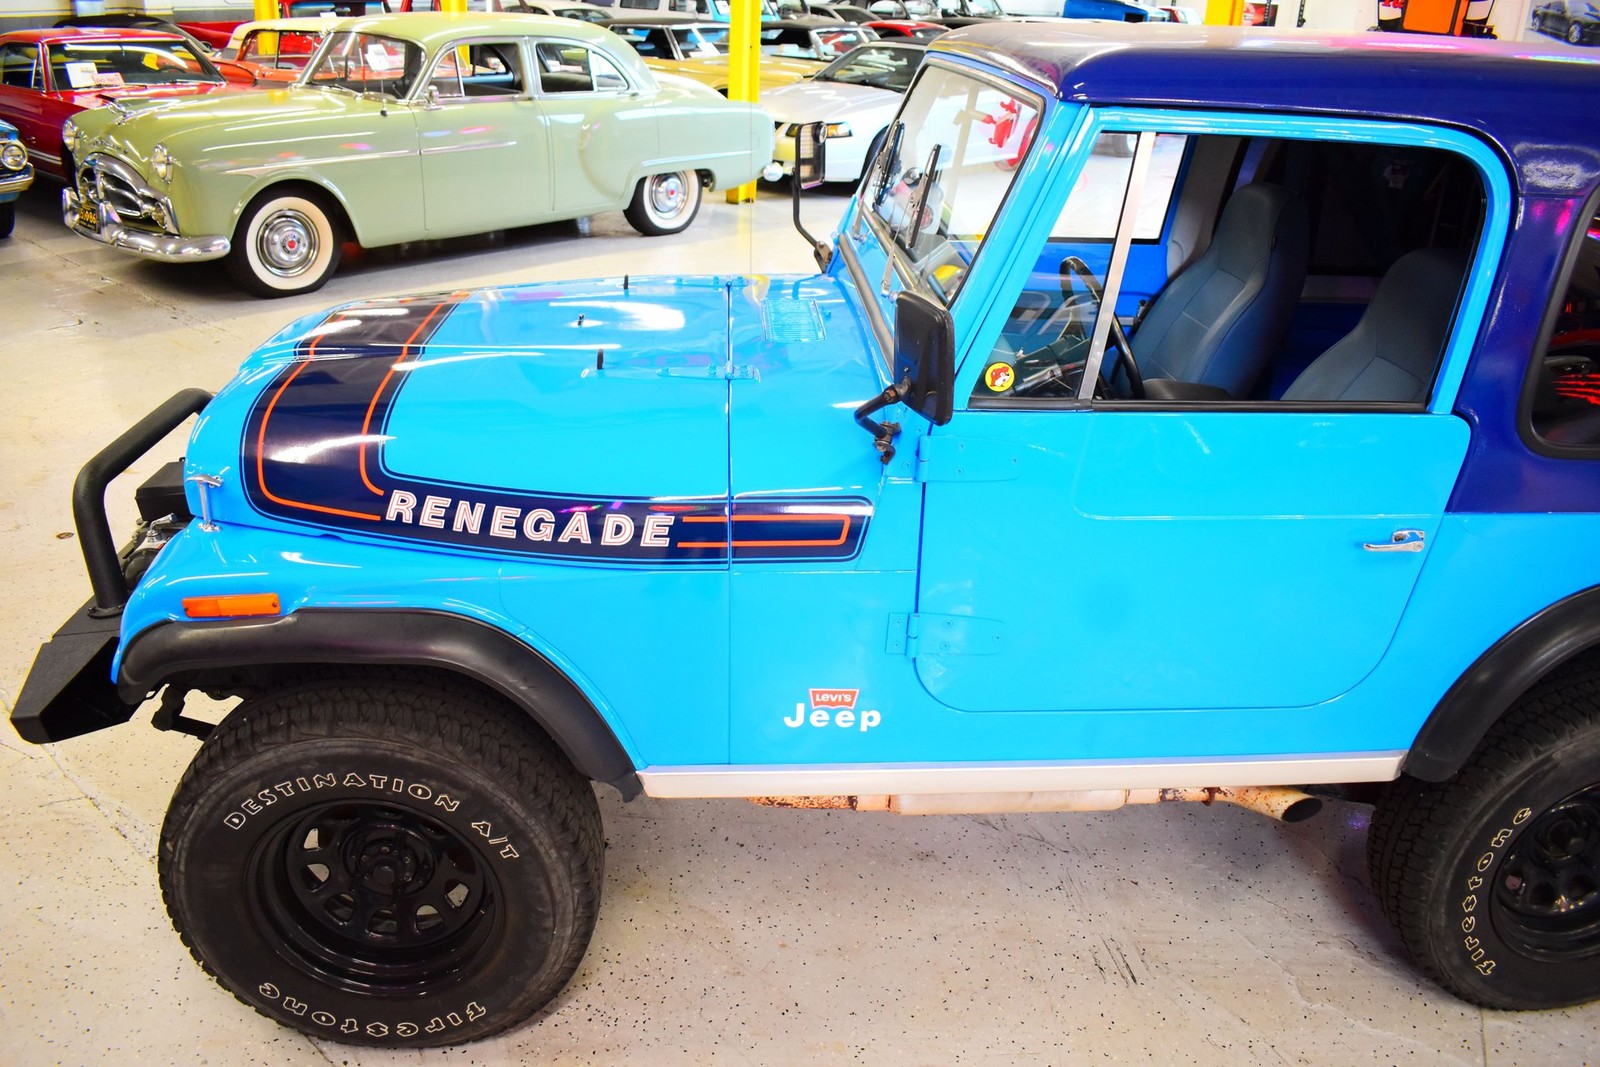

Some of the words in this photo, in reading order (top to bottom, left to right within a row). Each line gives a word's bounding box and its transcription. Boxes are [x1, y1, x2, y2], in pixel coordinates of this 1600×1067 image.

[385, 489, 675, 547] RENEGADE
[783, 702, 882, 732] Jeep
[223, 772, 460, 830] DESTINATION
[471, 821, 520, 859] A/T
[1462, 807, 1532, 976] Firestone
[259, 982, 487, 1037] Firestone
